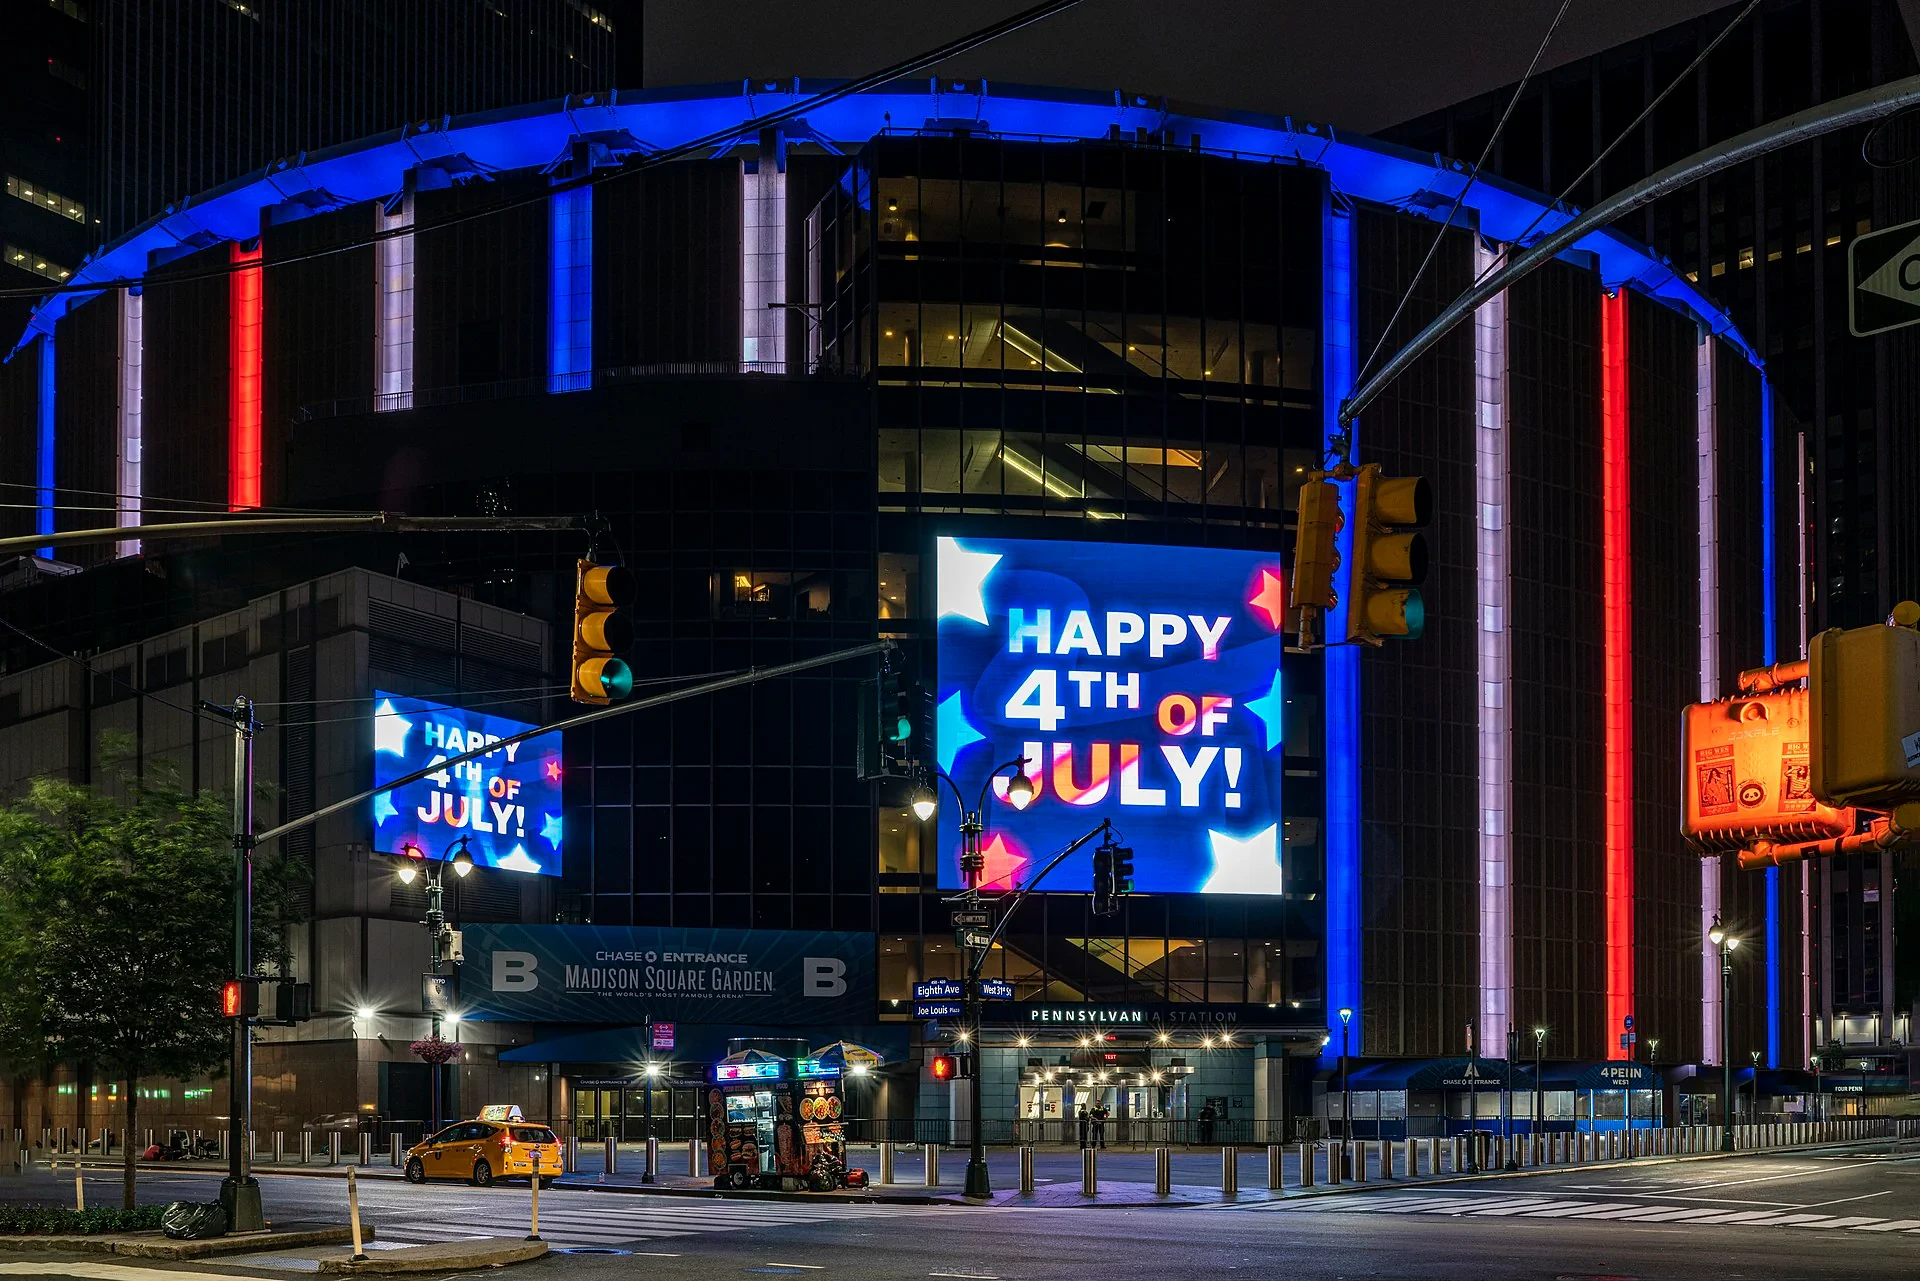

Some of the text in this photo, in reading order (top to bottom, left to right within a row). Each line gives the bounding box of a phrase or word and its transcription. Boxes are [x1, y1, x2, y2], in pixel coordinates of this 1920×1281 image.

[1009, 608, 1232, 660] HAPPY
[1005, 669, 1233, 736] 4TH OF
[425, 721, 521, 762] HAPPY
[424, 754, 521, 800] 4TH OF
[992, 741, 1242, 808] JULY!
[417, 790, 525, 837] JULY!
[492, 951, 539, 992] B
[595, 951, 748, 964] CHASE ENTRANCE
[565, 964, 774, 992] MADISON SQUARE GARDEN
[803, 957, 848, 997] B
[917, 985, 960, 997] Eighth Ave
[983, 984, 996, 995] West
[917, 1006, 929, 1015] Joe
[930, 1005, 948, 1015] Louis
[1031, 1010, 1237, 1022] PENNSYLVANIA STATION
[1464, 1062, 1480, 1077] A
[1600, 1067, 1642, 1078] 4 PENN
